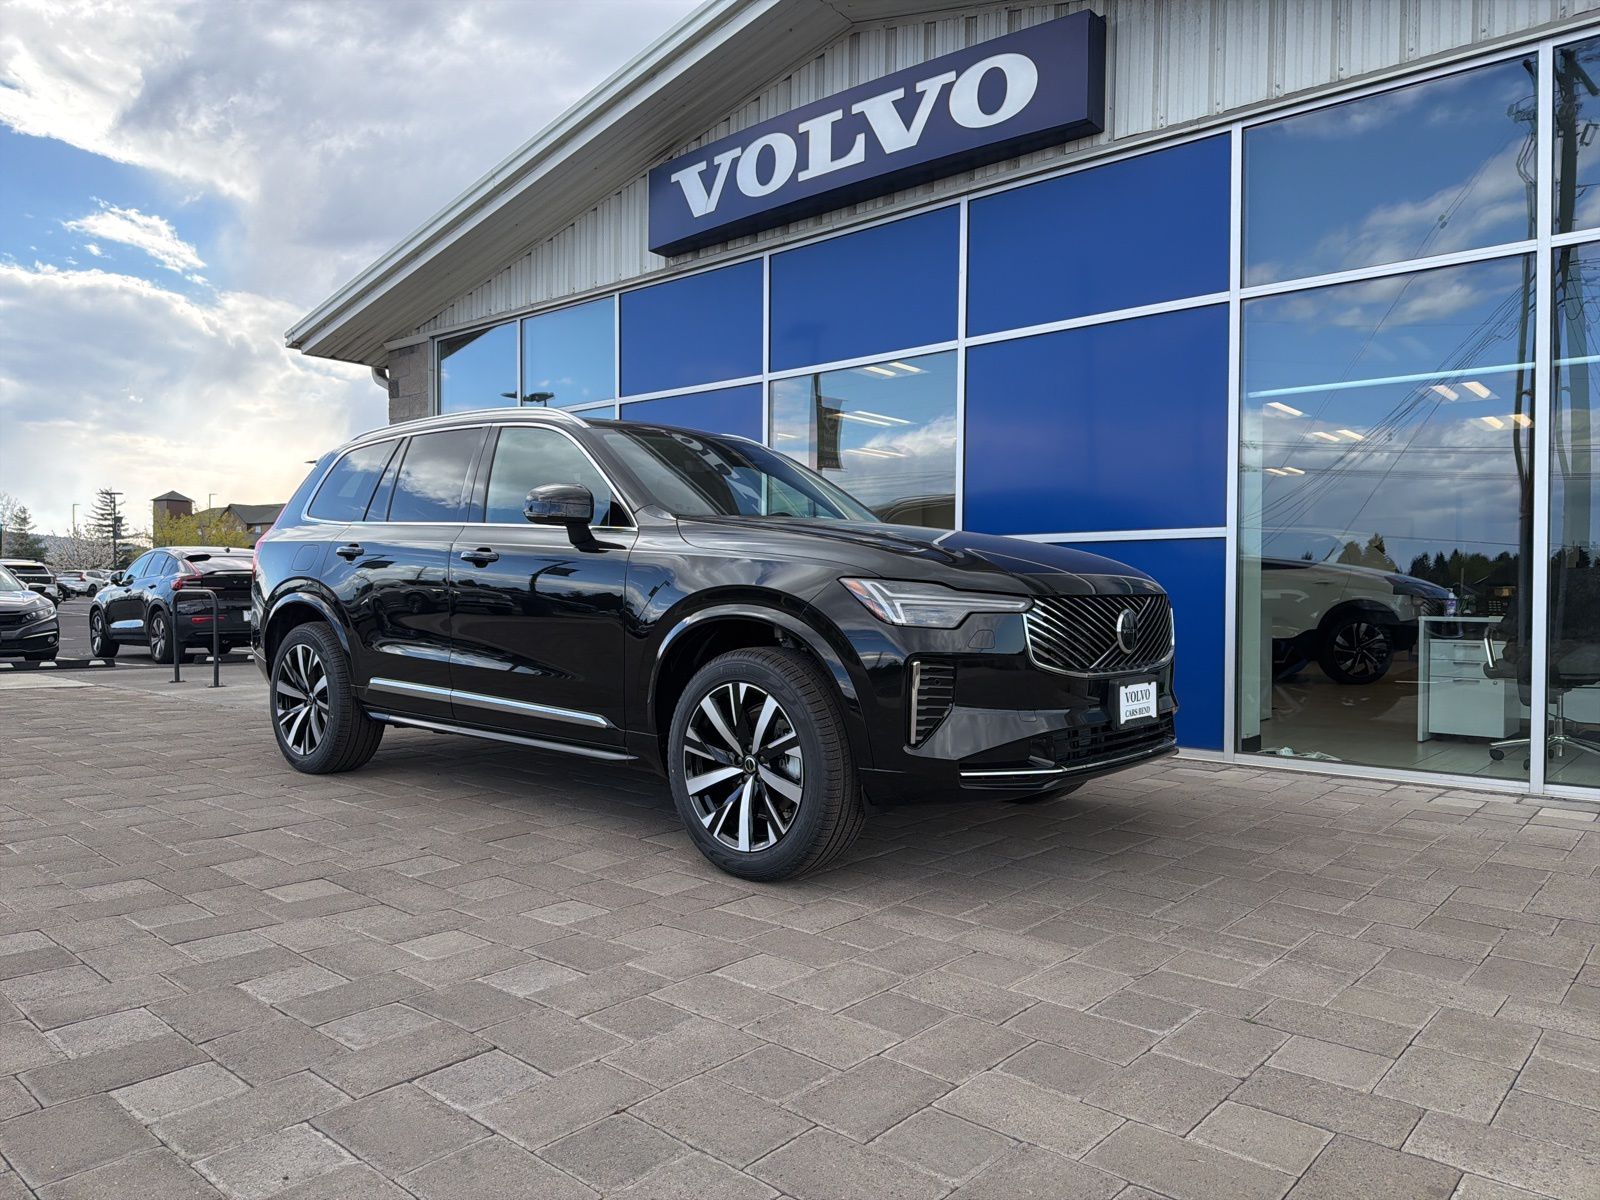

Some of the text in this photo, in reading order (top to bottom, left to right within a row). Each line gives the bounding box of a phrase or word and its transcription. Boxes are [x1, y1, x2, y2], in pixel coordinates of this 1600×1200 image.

[671, 53, 1038, 218] VOLVO
[1125, 689, 1151, 703] VOLVO
[1125, 706, 1151, 717] CARS BEND
